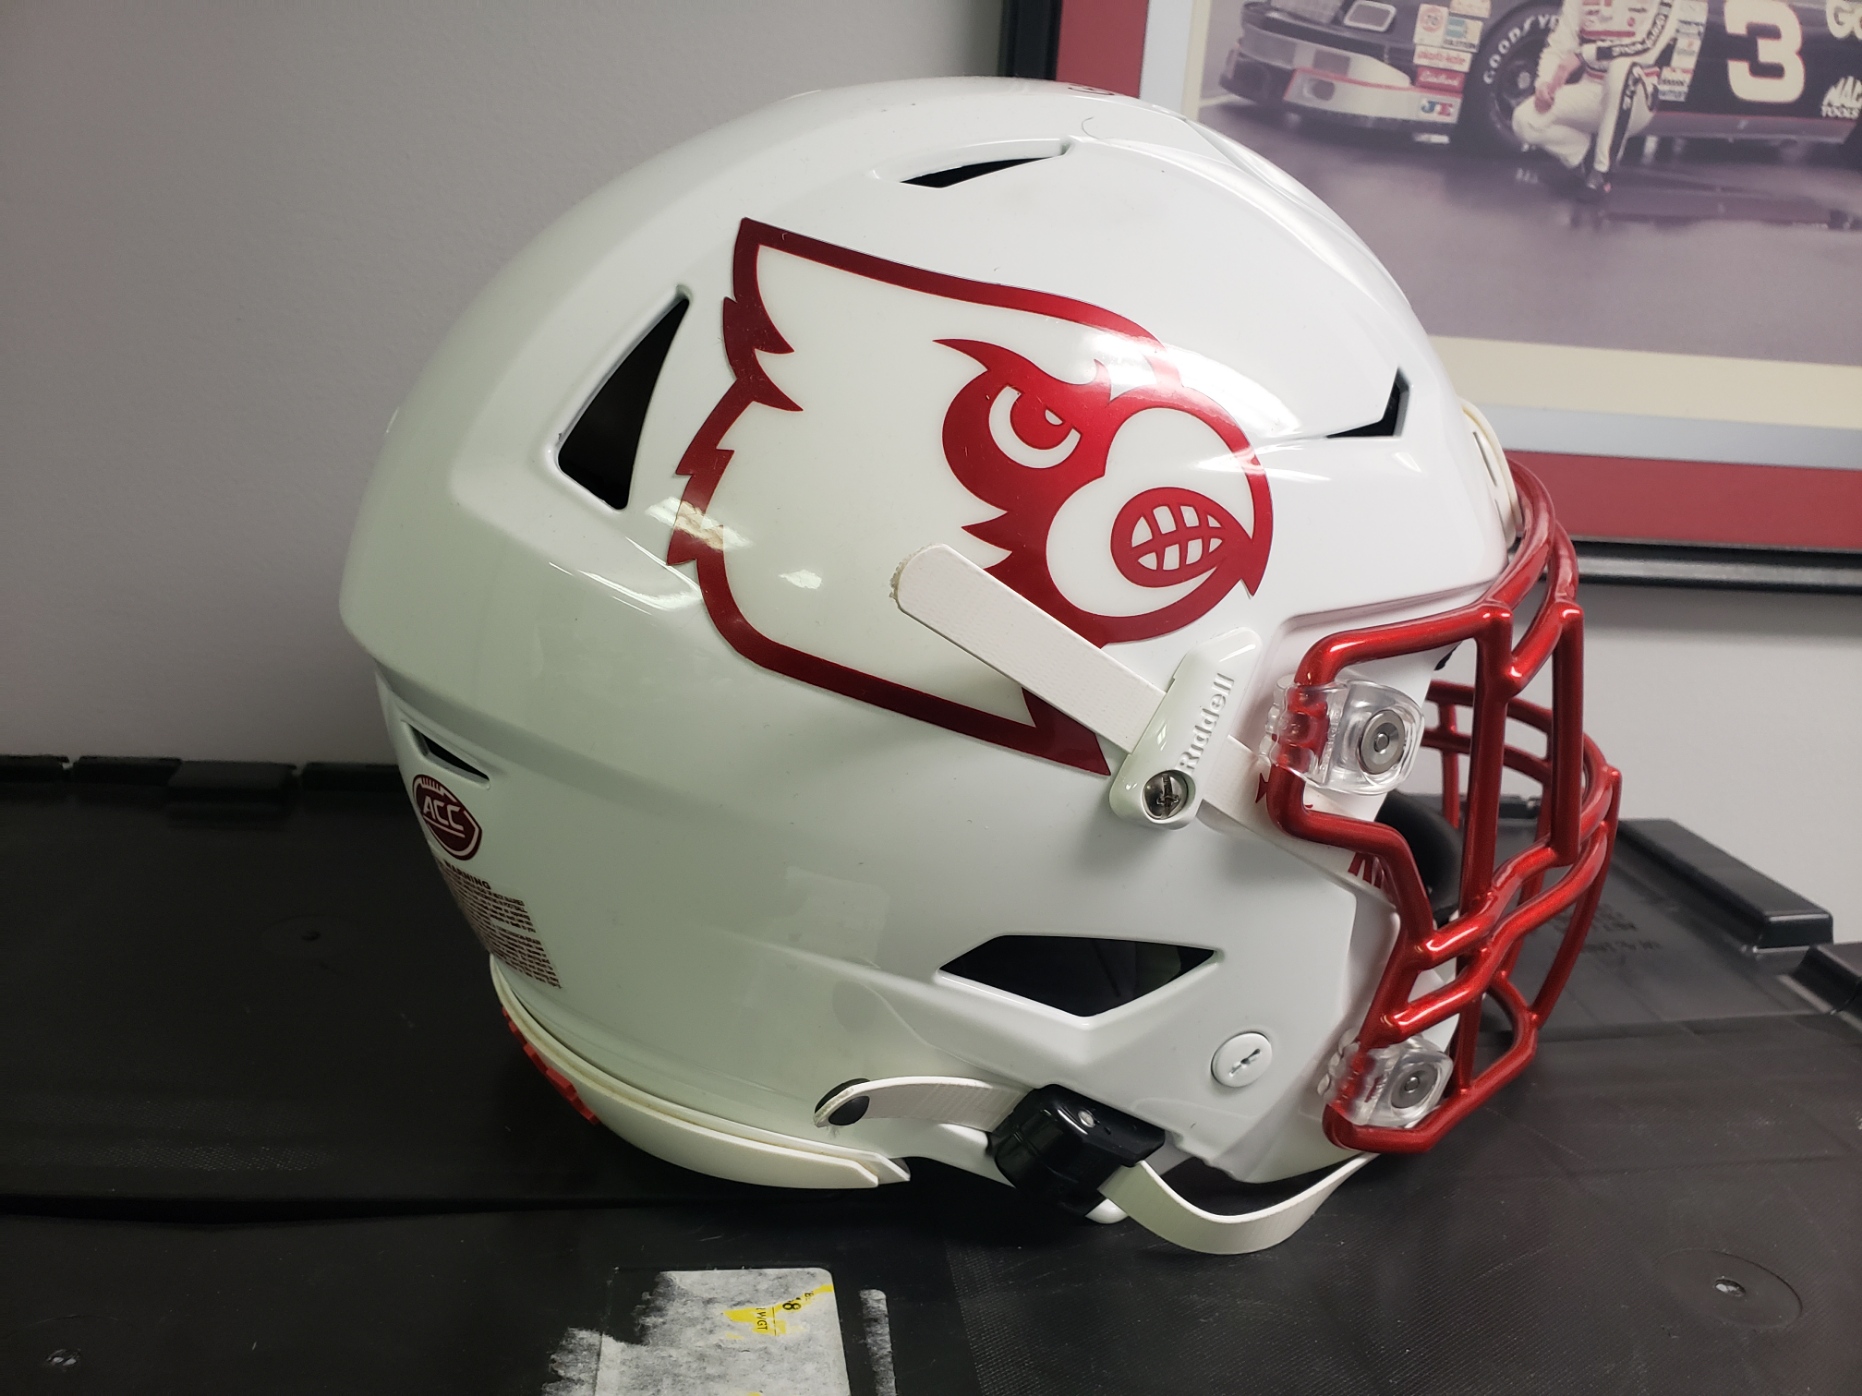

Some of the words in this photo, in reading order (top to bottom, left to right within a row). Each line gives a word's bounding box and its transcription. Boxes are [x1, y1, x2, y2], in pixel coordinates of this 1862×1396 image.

[1723, 0, 1806, 103] 3
[1821, 105, 1860, 119] TOOLS
[1176, 672, 1235, 773] Riddell
[422, 795, 465, 832] ACC
